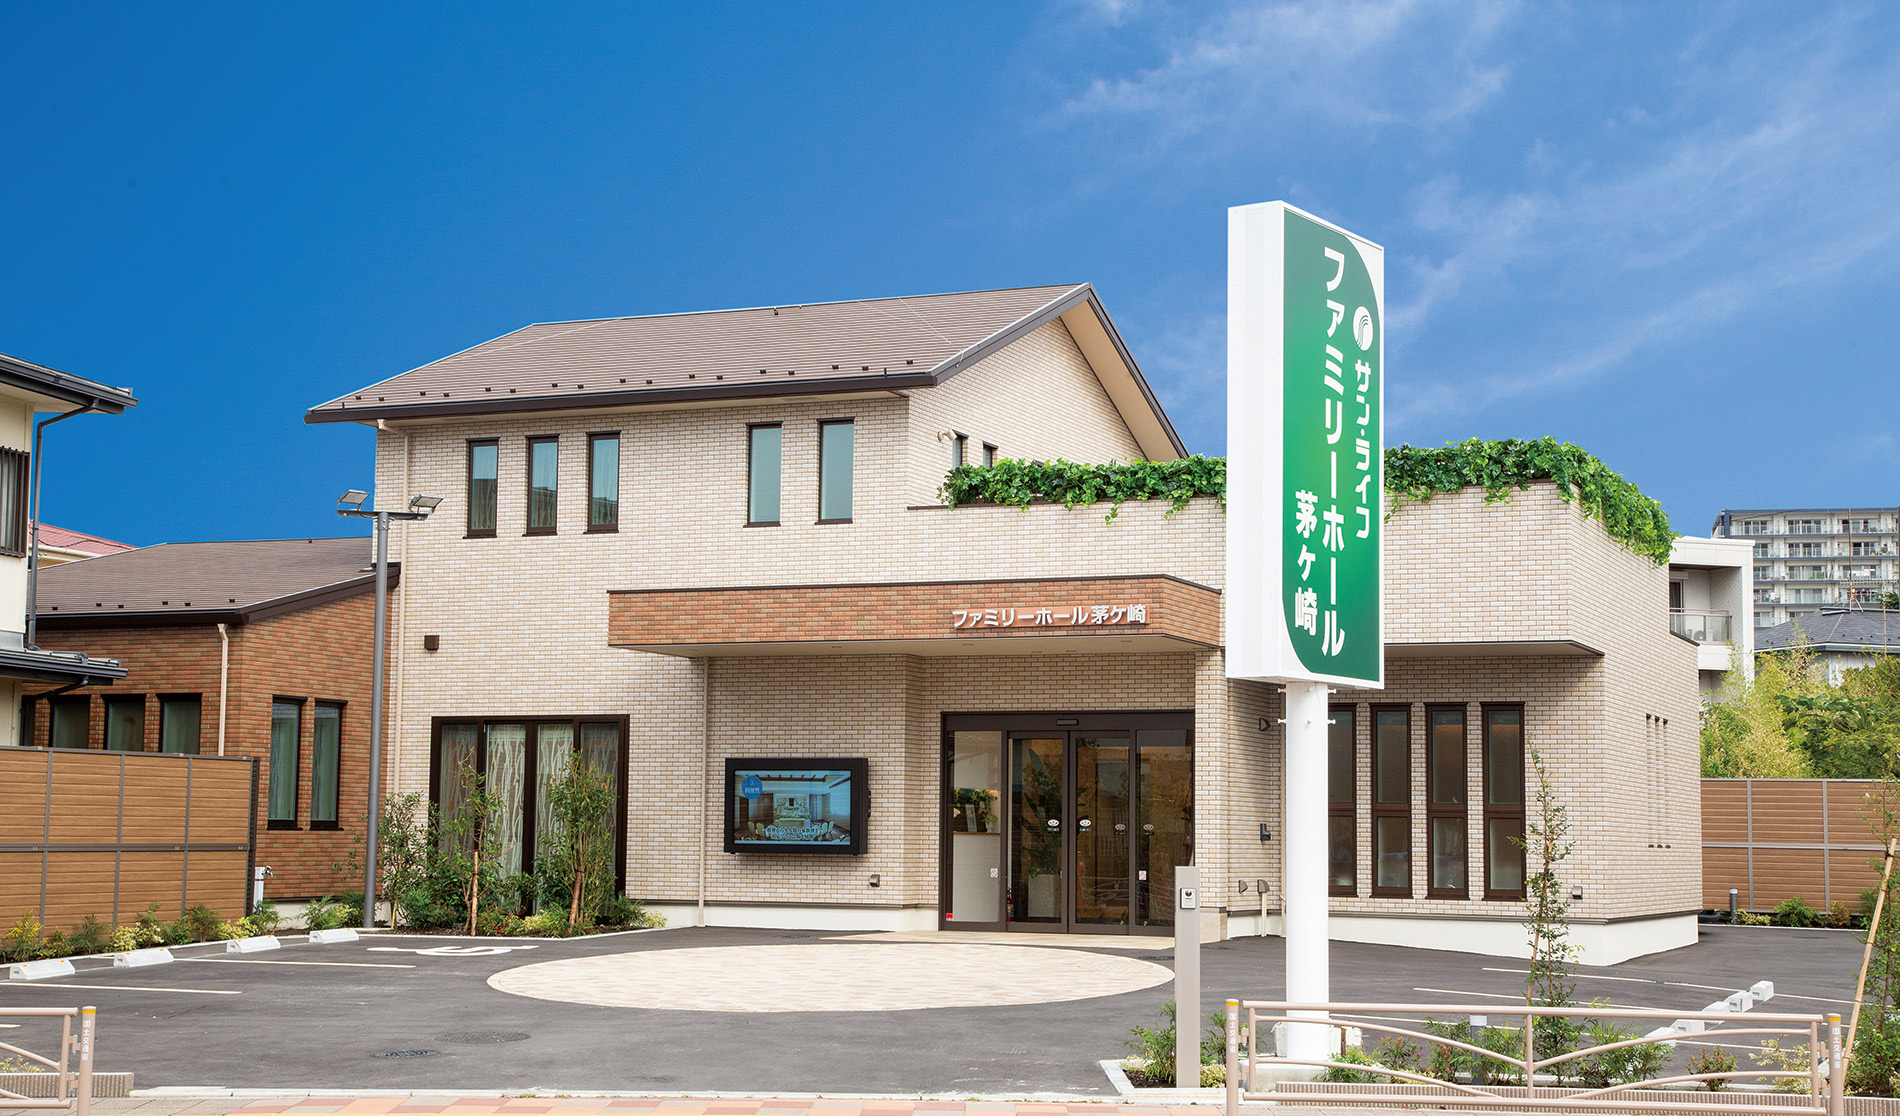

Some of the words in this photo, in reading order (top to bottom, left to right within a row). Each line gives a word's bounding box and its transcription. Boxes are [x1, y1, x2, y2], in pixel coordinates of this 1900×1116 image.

[1321, 246, 1347, 658] ファミリーホール
